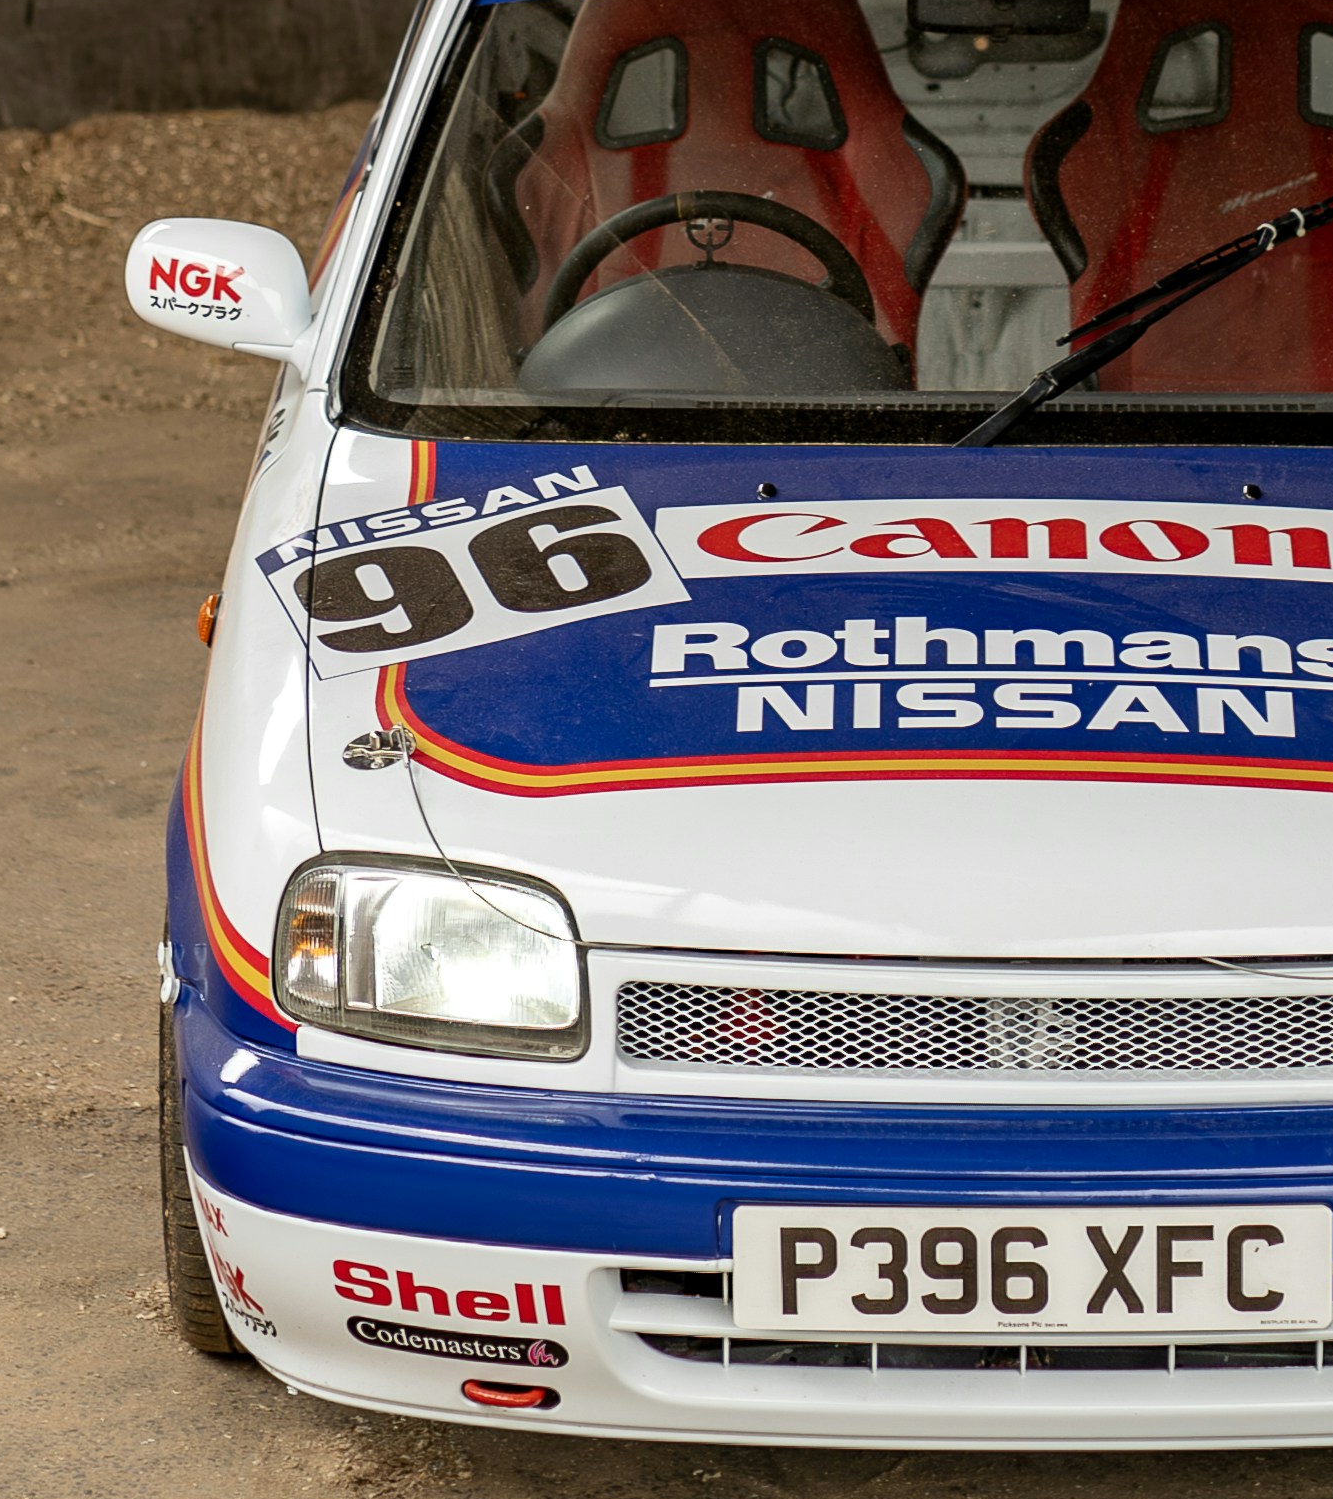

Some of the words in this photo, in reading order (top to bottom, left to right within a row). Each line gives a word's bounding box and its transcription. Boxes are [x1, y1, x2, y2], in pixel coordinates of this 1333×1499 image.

[149, 256, 246, 304] NGK
[149, 295, 243, 322] スパークプラグ
[276, 464, 599, 564] NISSAN
[696, 512, 1332, 570] Canon
[293, 504, 652, 653] 96
[736, 682, 1297, 738] NISSAN
[333, 1259, 567, 1325] Shell
[779, 1225, 1050, 1315] P396
[1085, 1224, 1286, 1314] XFC
[355, 1321, 523, 1360] Codemasters
